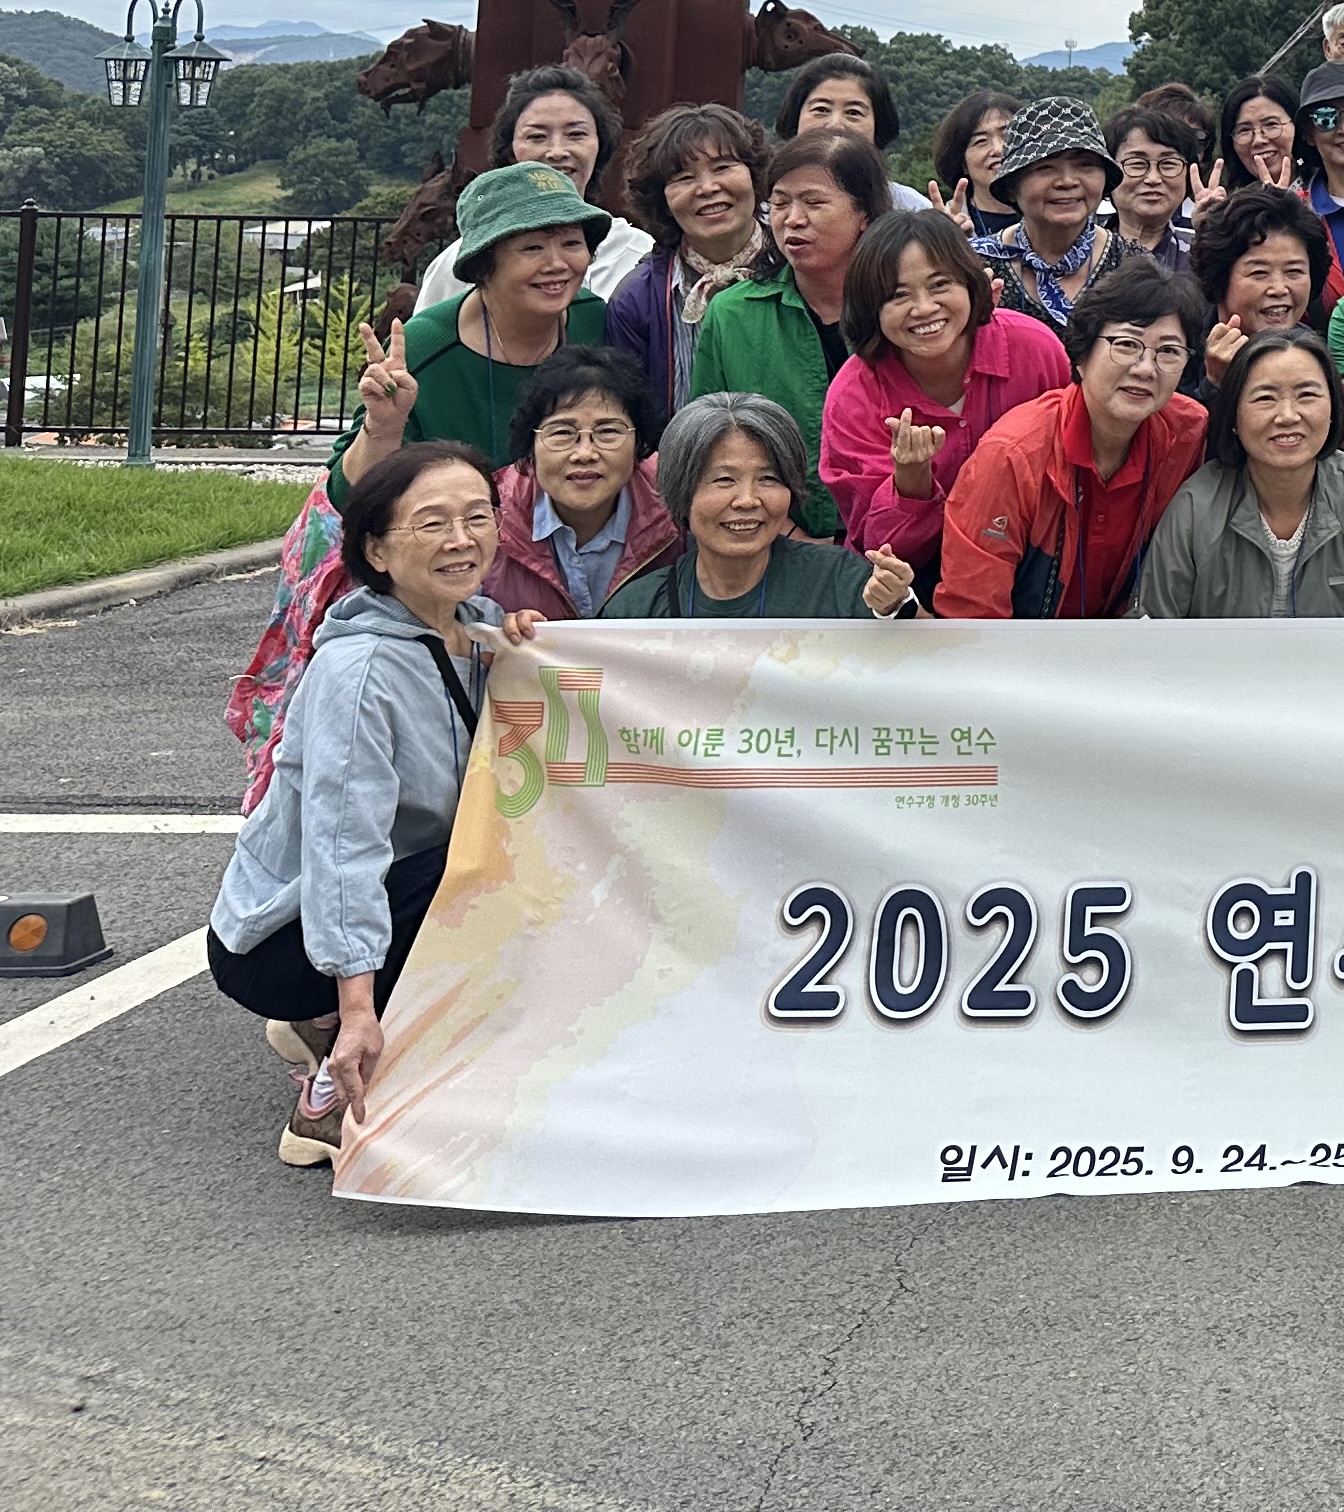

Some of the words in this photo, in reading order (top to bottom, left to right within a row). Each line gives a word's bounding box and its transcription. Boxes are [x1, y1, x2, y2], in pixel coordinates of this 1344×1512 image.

[617, 726, 666, 756] 함께
[677, 727, 725, 758] 이룬
[737, 726, 802, 758] 30년,
[814, 726, 860, 755] 다시
[871, 727, 940, 756] 꿈꾸는
[950, 726, 997, 756] 연수
[895, 795, 935, 809] 연수구청
[964, 794, 998, 807] 30주년
[766, 880, 1134, 1023] 2025
[940, 1145, 1033, 1182] 일시:
[1046, 1146, 1153, 1178] 2025.
[1171, 1145, 1203, 1174] 9.
